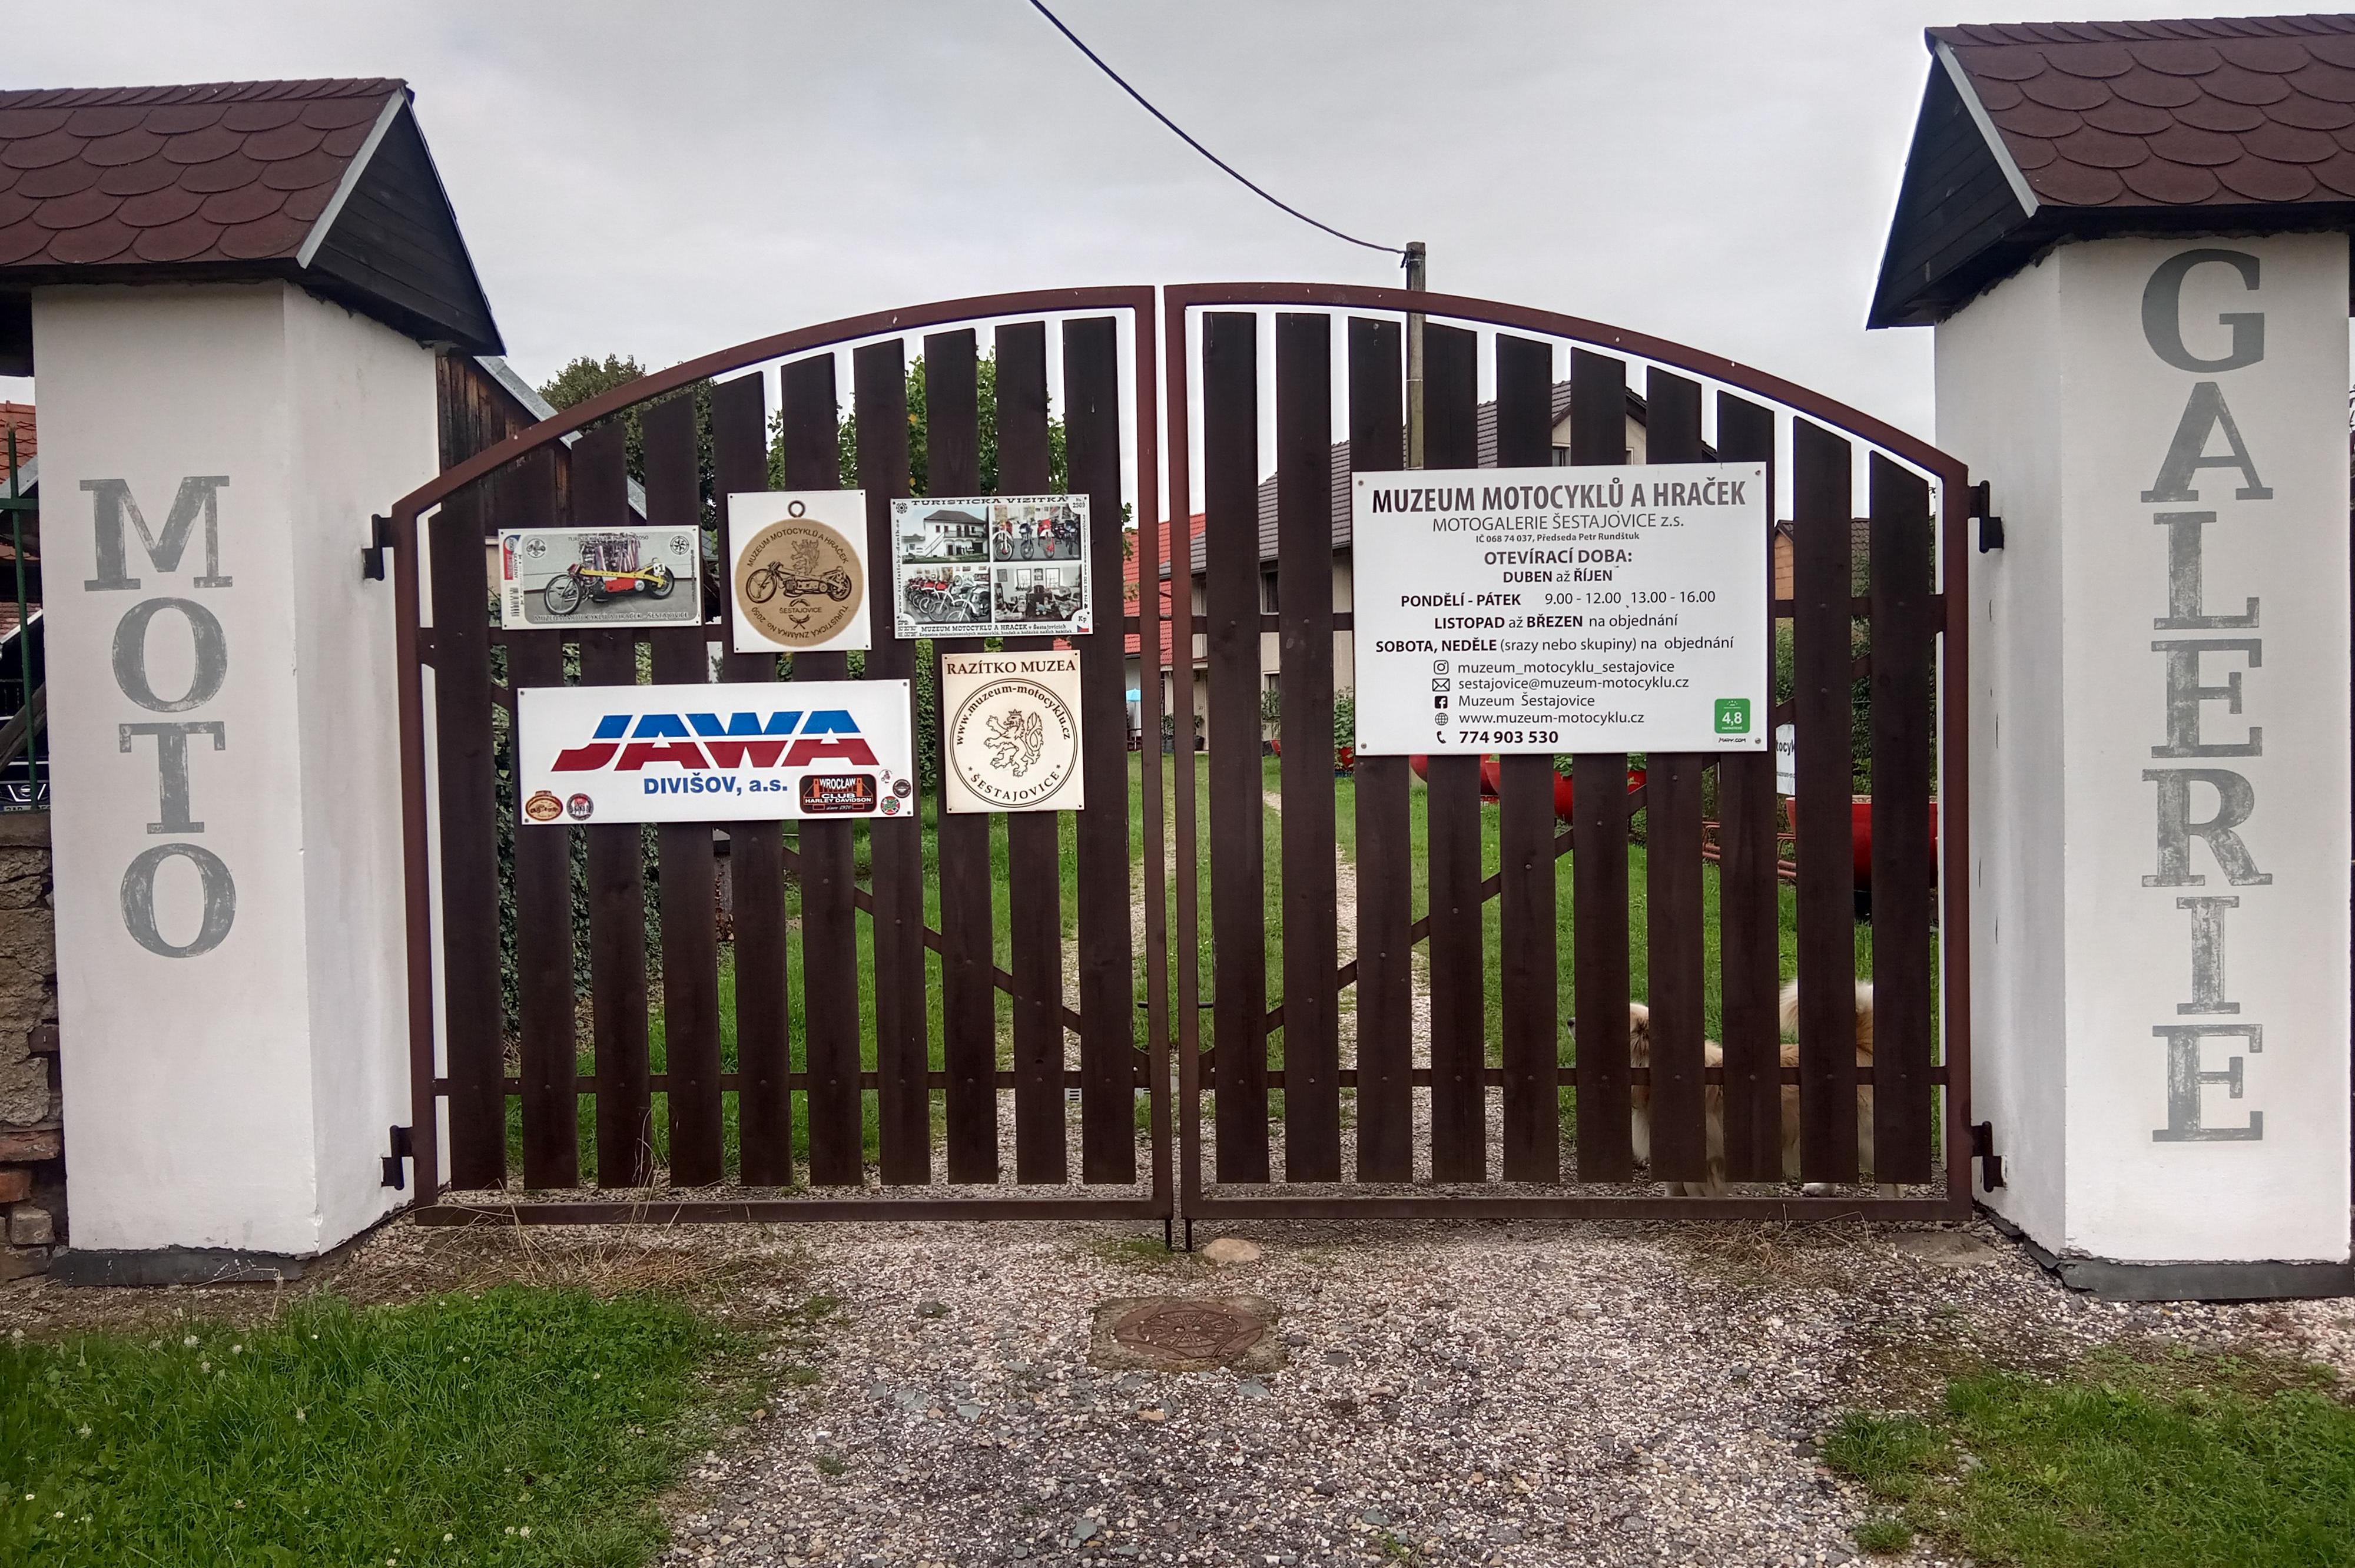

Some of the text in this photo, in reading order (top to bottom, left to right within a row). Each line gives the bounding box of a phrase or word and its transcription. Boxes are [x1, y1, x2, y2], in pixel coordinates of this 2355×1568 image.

[1373, 477, 1746, 513] MUZEUM MOTOCYKLŮ A HRAČEK
[1434, 511, 1683, 532] MOTOGALERIE ŠESTAJOVICE z.s.
[1477, 534, 1484, 542] IČ
[1598, 532, 1639, 540] Rundštuk
[747, 538, 770, 567] MUZEUM
[770, 528, 818, 541] MOTOCYKLŮ
[824, 537, 848, 564] HRAČEK
[1485, 548, 1631, 565] OTEVÍRACÍ DOBA:
[1504, 568, 1612, 582] DUBEN až ŘÍJEN
[1402, 592, 1464, 606] PONDĚLÍ
[1477, 592, 1521, 605] PÁTEK
[1545, 593, 1573, 604] 9.00
[1586, 592, 1621, 604] 12.00
[1631, 592, 1666, 603] 13.00
[1680, 591, 1715, 602] 16.00
[751, 606, 767, 623] 2050
[1435, 614, 1677, 629] LISTOPAD až BŘEZEN na objednání
[1376, 637, 1733, 654] SOBOTA, NEDĚLE (srazy nebo skupiny) na objednání
[947, 659, 1076, 675] RAZÍTKO MUZEA
[1458, 661, 1674, 675] muzeum_motocyklu_sestajovice
[1459, 677, 1689, 692] sestajovice@muzeum-motocyklu.cz
[1459, 692, 1594, 709] Muzeum Šestajovice
[2141, 248, 2273, 1142] GALERIE
[79, 475, 236, 959] MOTO
[957, 685, 1070, 745] www.muzeum-motocyklu.cz
[1459, 711, 1644, 725] www.muzeum-motocyklu.cz
[1722, 712, 1743, 726] 4,8
[550, 710, 880, 772] JAWA
[1460, 731, 1558, 743] 774 903 530
[644, 773, 787, 796] DIVIŠOV, a.s.
[819, 778, 856, 790] WROCŁAW
[970, 771, 1060, 802] ŠESTAJOVICE
